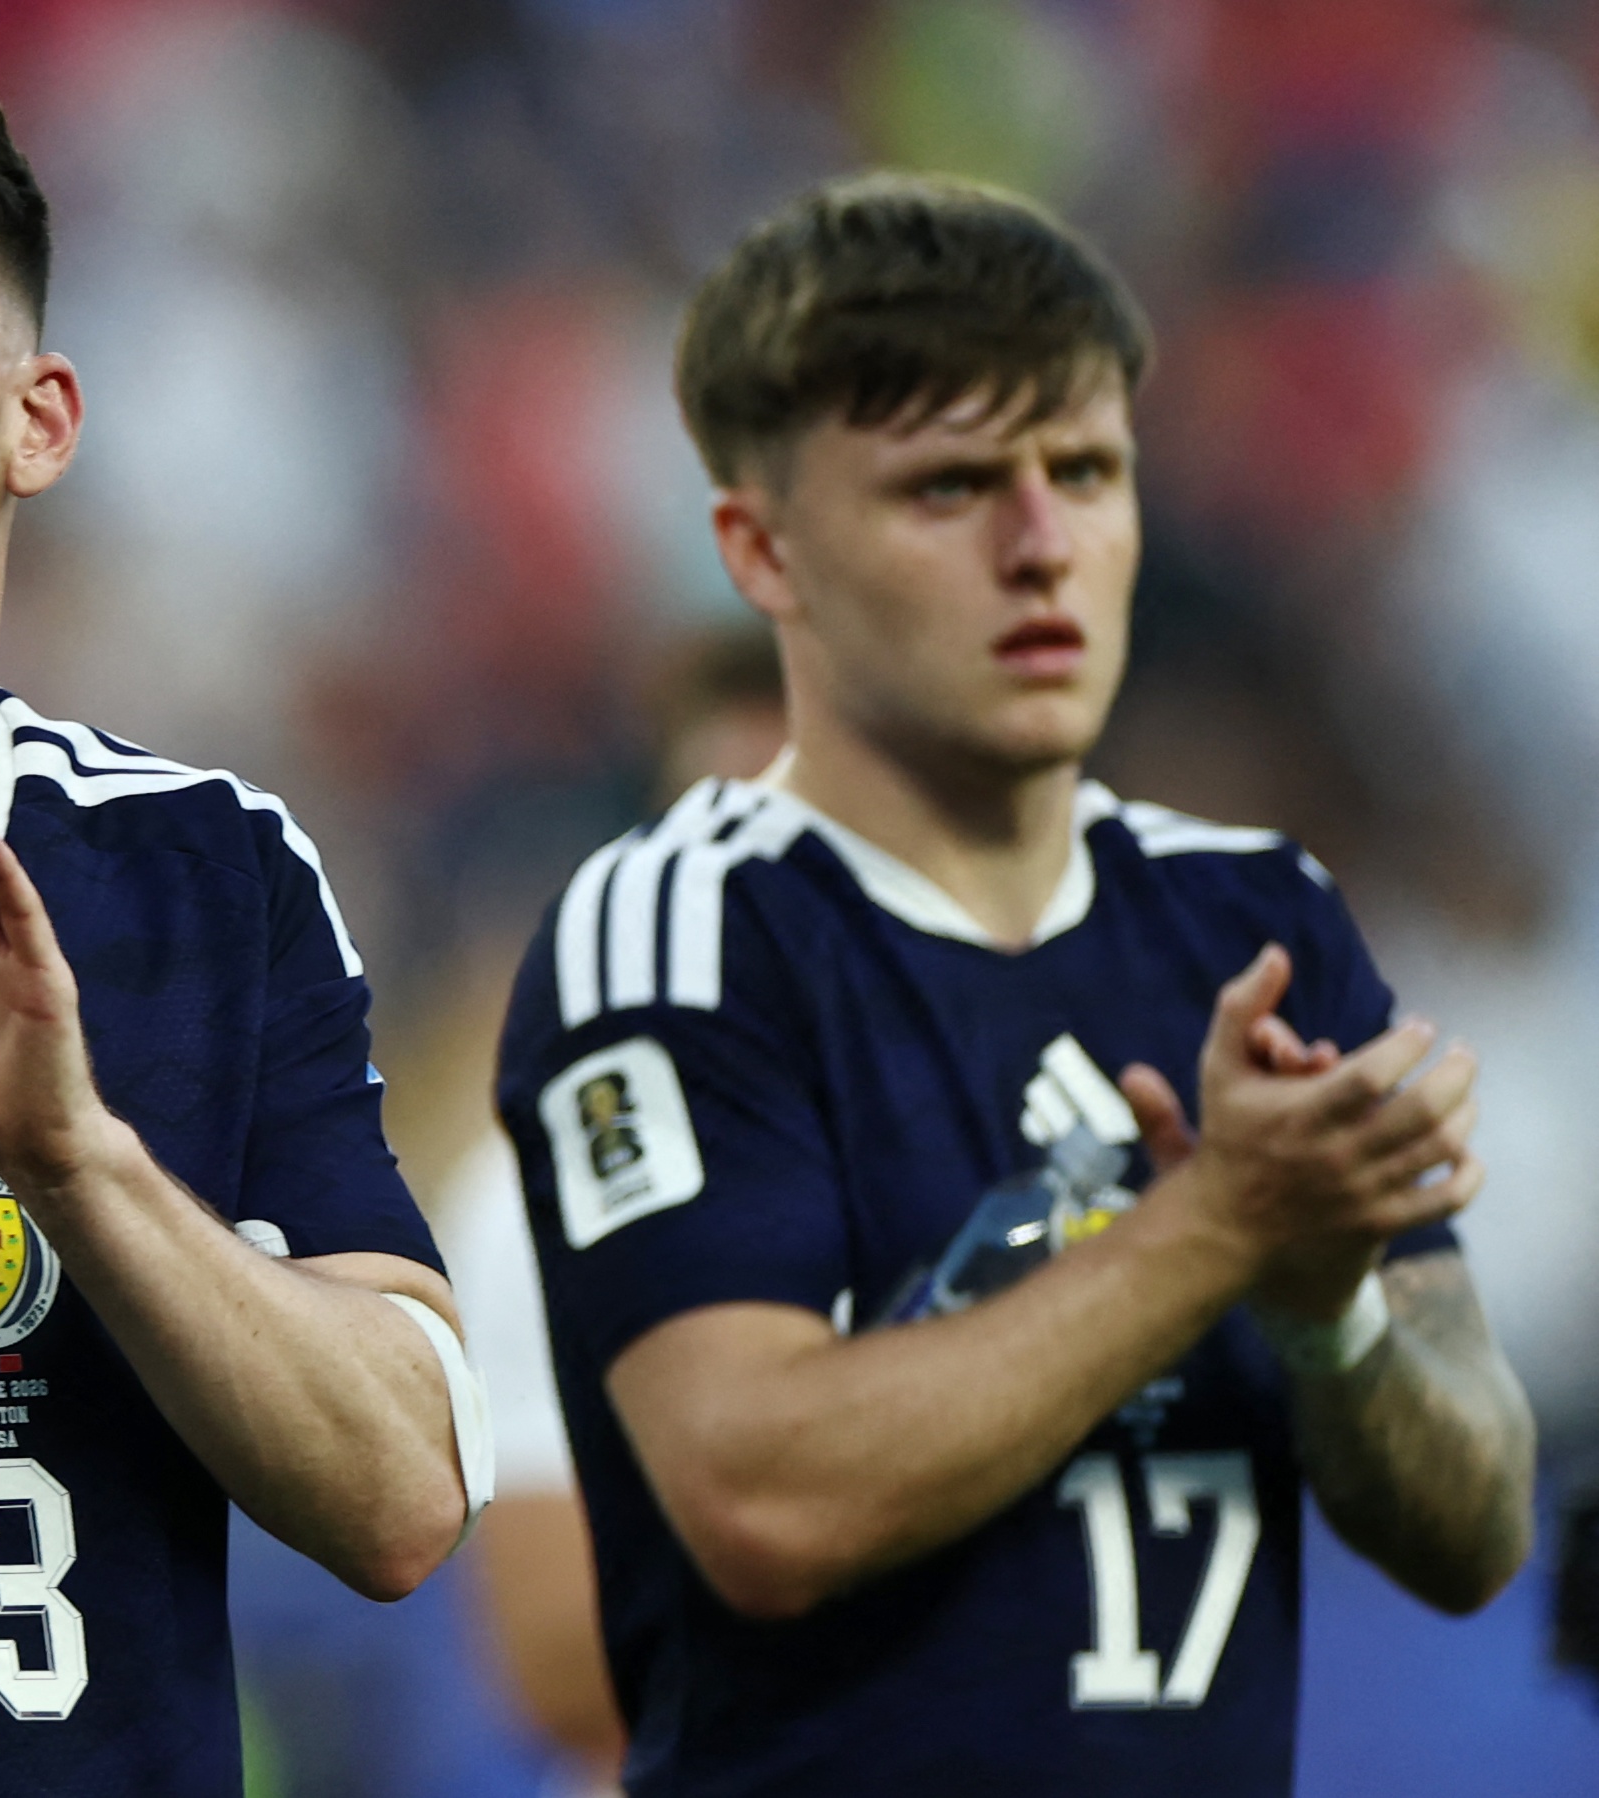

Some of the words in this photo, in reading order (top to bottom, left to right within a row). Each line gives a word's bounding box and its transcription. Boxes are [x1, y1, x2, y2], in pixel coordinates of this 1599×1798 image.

[19, 1303, 46, 1332] 1873
[9, 1378, 49, 1398] 2026
[1056, 1449, 1262, 1711] 17
